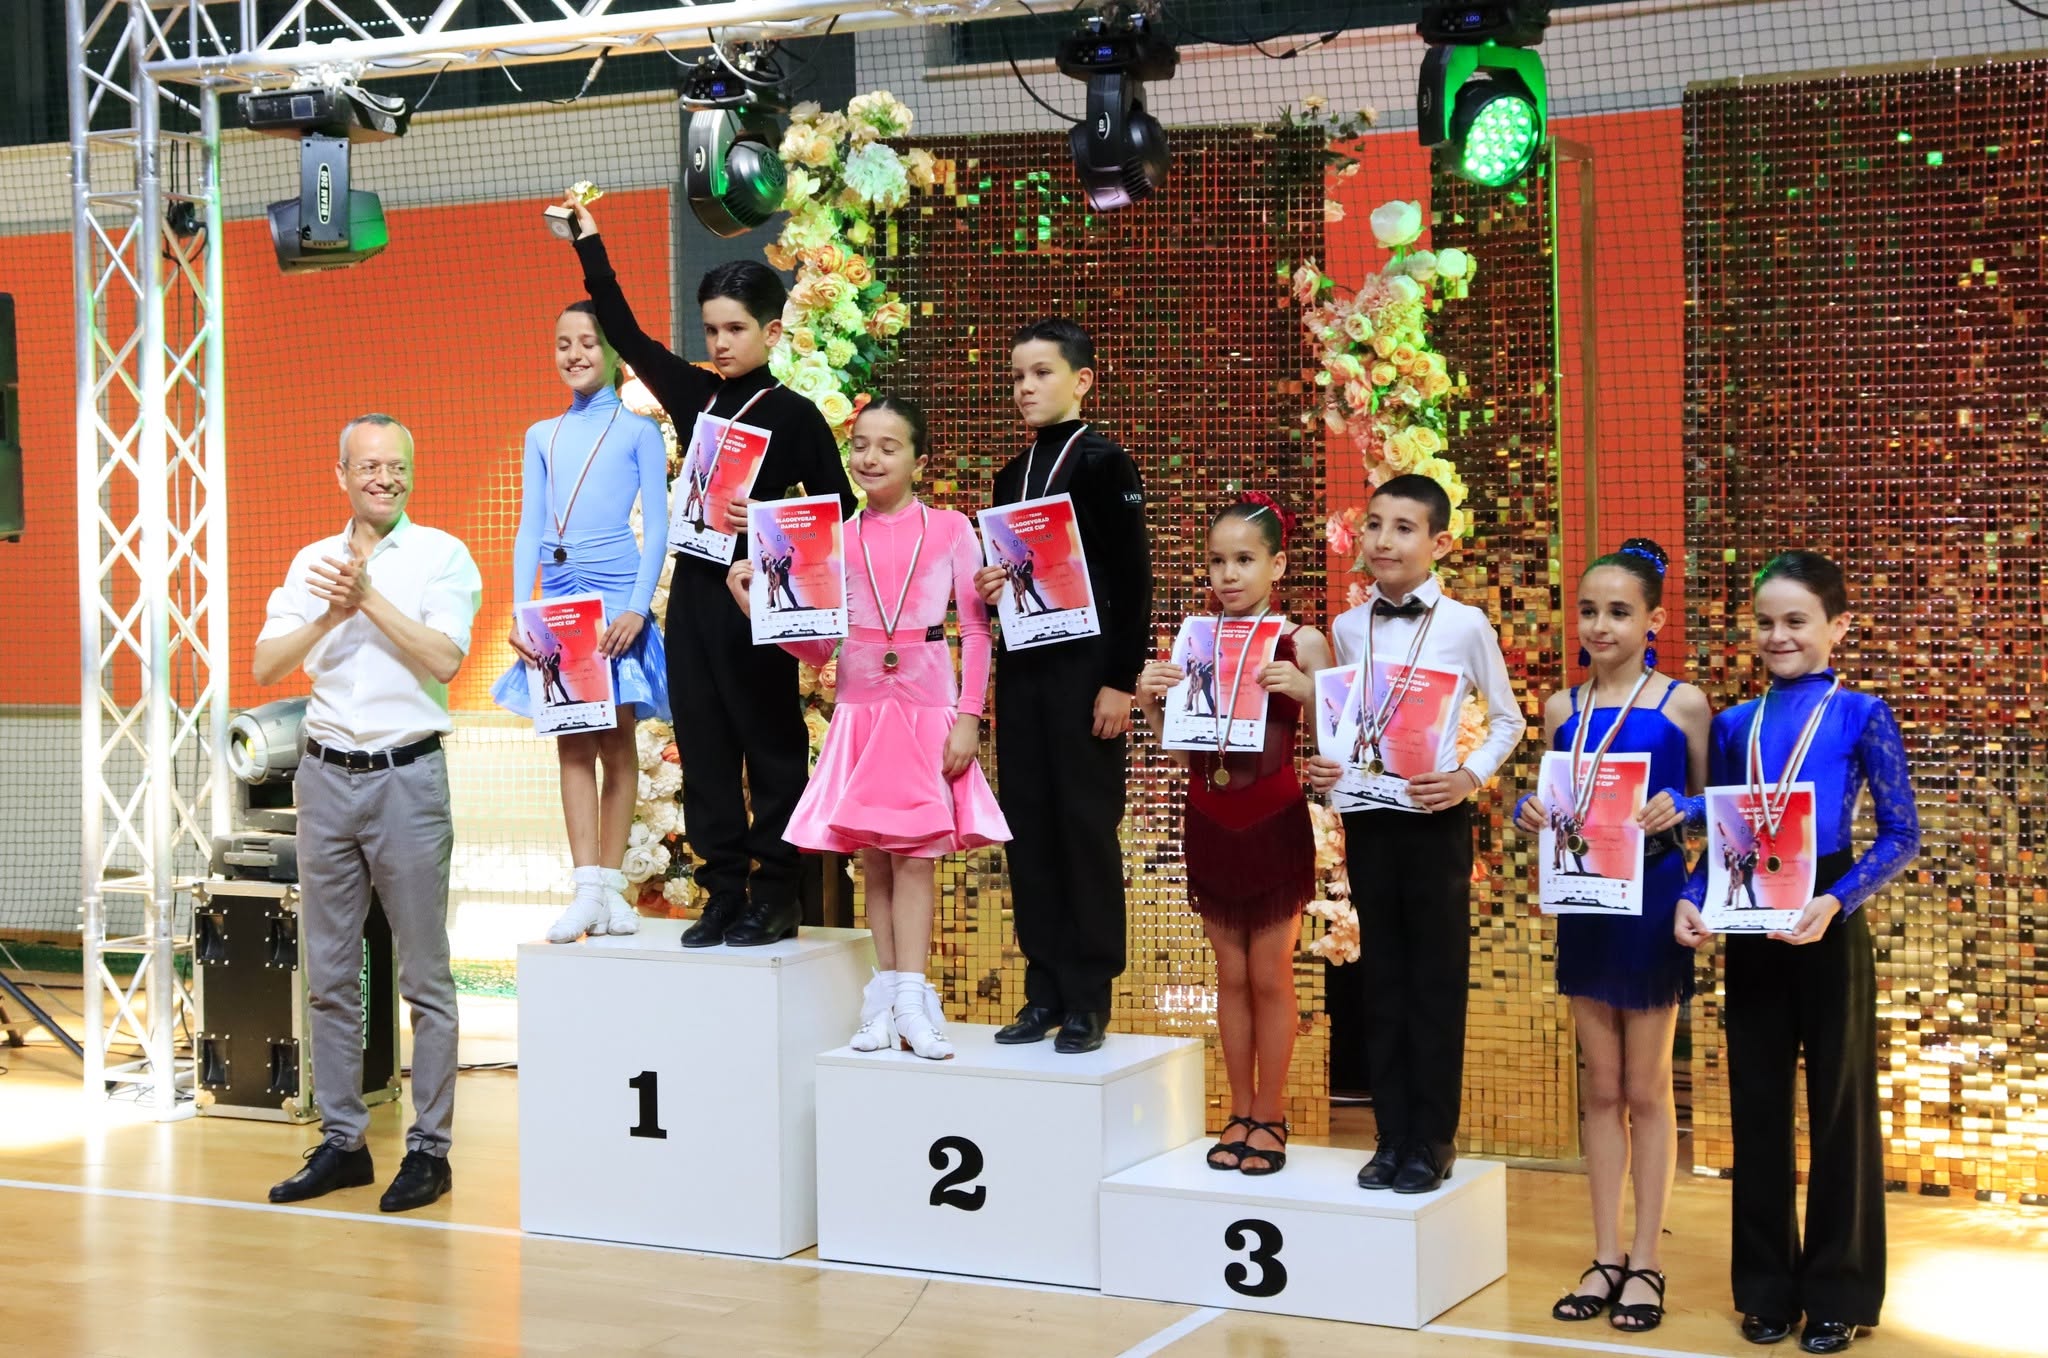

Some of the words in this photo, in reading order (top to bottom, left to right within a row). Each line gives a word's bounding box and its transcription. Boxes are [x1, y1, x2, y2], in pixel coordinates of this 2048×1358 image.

[320, 170, 329, 188] 200
[320, 189, 329, 216] BEAM
[775, 515, 817, 524] BLAGOEVGRAD
[1008, 516, 1050, 529] BLAGOEVGRAD
[1014, 526, 1034, 534] DANCE
[542, 613, 581, 622] BLAGOEVGRAD
[630, 1071, 667, 1140] 1
[929, 1136, 987, 1211] 2
[1224, 1219, 1287, 1297] 3
